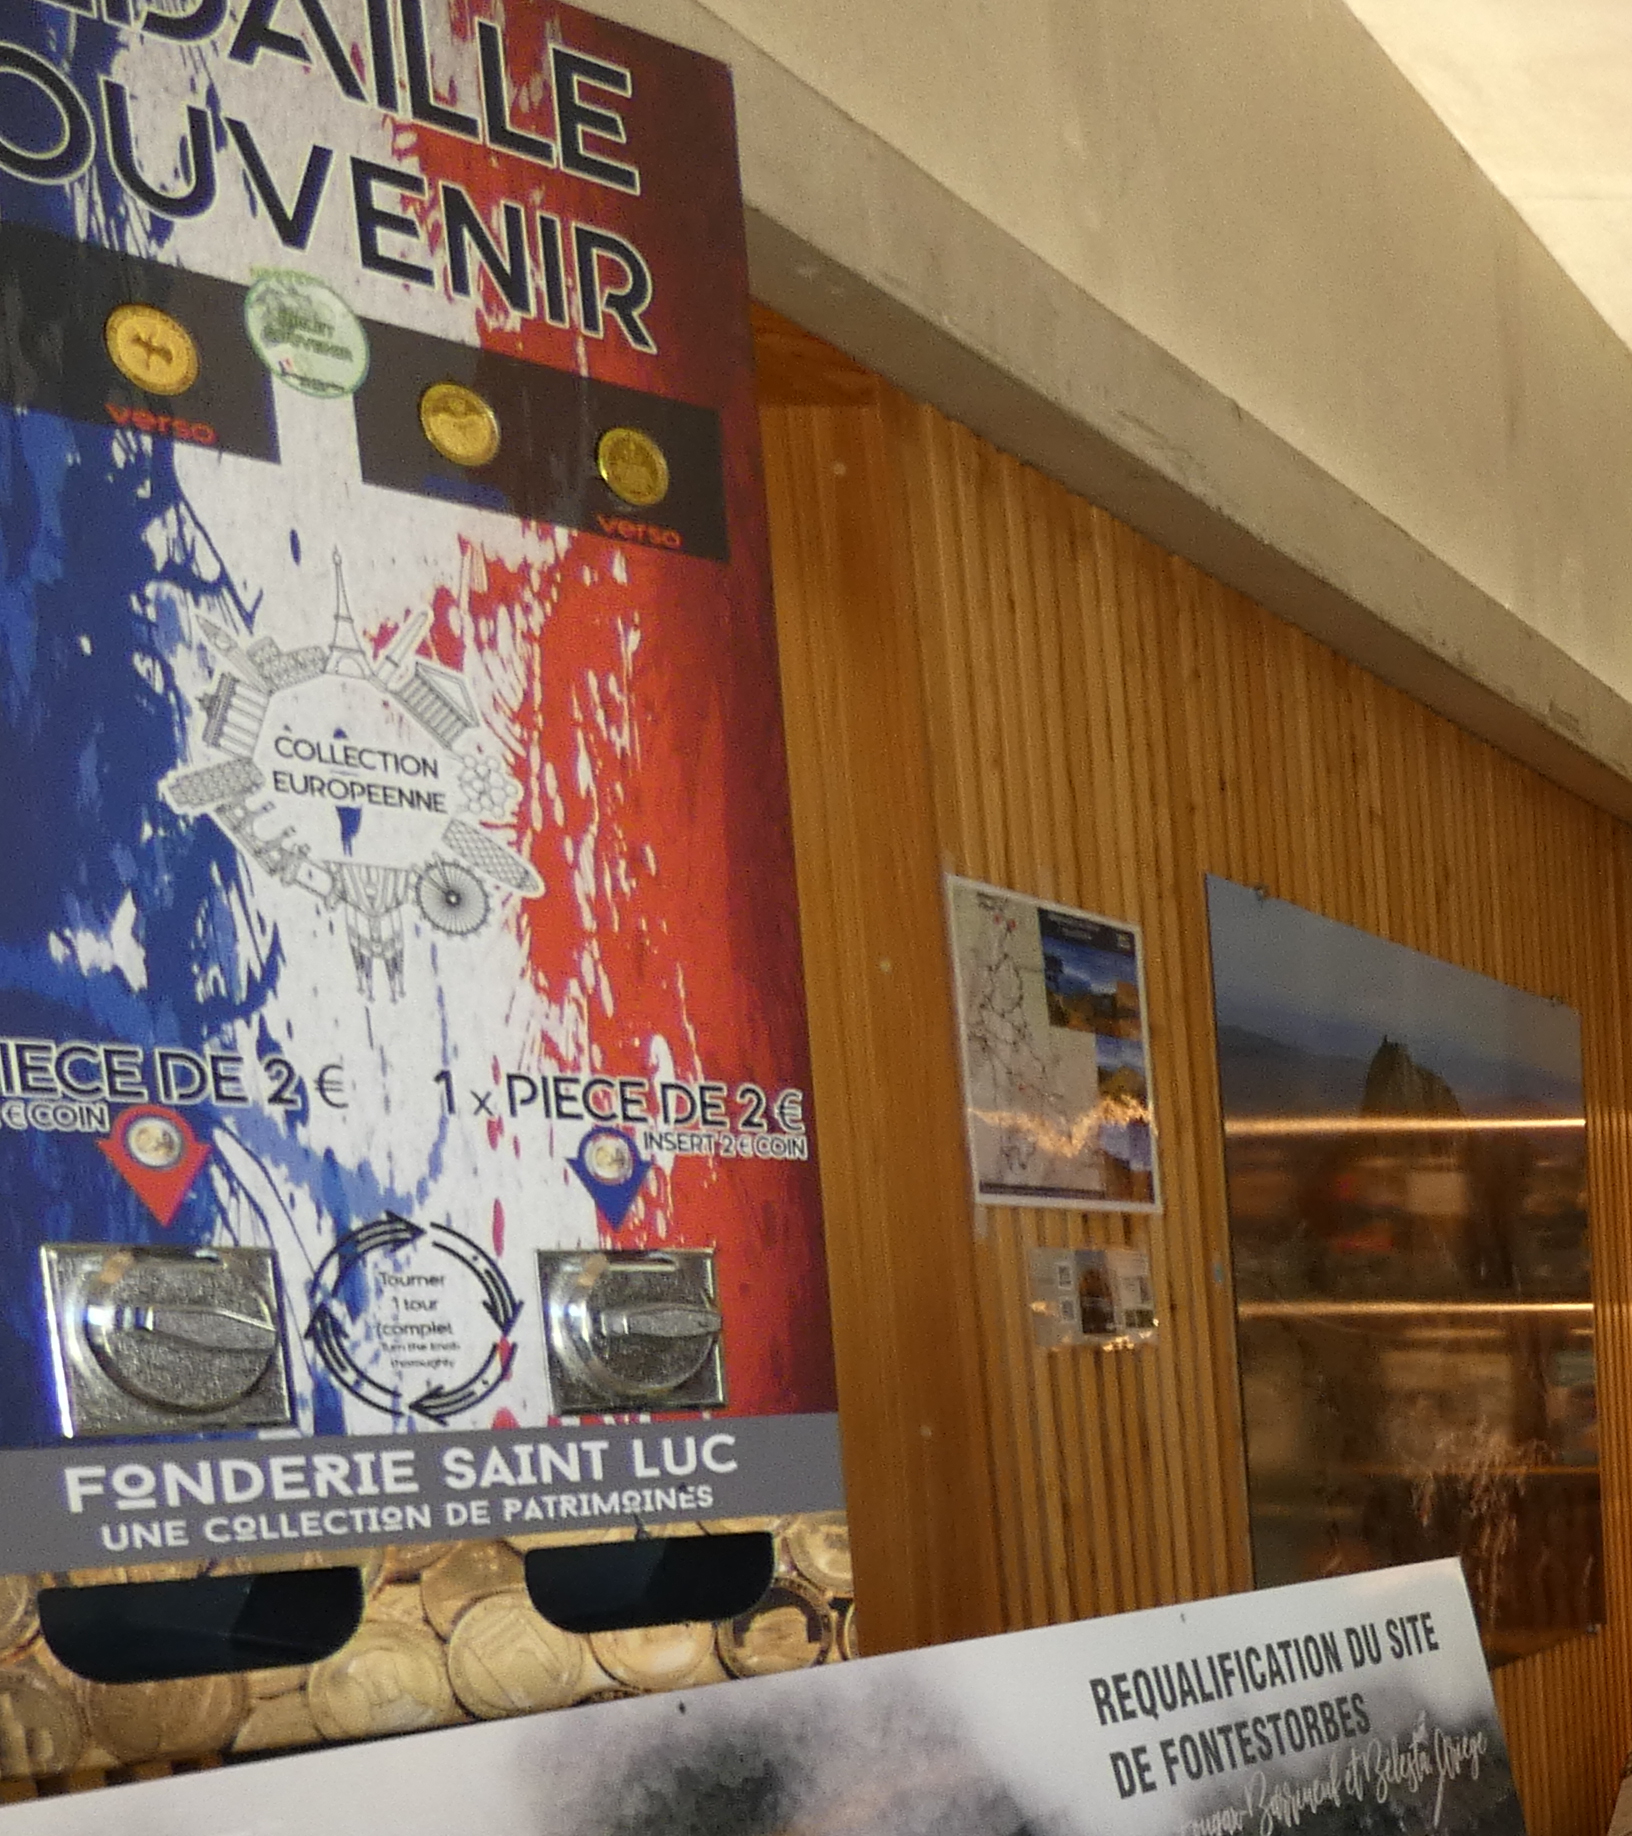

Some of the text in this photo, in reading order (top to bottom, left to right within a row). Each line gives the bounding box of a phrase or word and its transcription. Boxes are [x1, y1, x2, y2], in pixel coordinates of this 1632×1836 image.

[57, 0, 638, 196] AILLE
[107, 403, 217, 445] verso
[598, 516, 682, 550] verso
[274, 733, 439, 779] COLLECTION
[272, 768, 448, 815] EUROPEENNE
[155, 1047, 251, 1106] DE
[263, 1056, 301, 1108] 2
[314, 1063, 349, 1109] €
[433, 1069, 805, 1133] 1 x PIECE DE 2 €
[29, 1103, 110, 1132] COIN
[643, 1131, 716, 1153] INSERT
[720, 1135, 735, 1157] 2
[755, 1136, 809, 1160] COIN
[65, 1433, 739, 1512] FONDERIE SAINT LUC
[102, 1486, 714, 1552] UNE COLLECTION DE PATRIMOINES
[1089, 1611, 1440, 1727] REQUALIFICATION DU SITE
[1110, 1693, 1371, 1800] DE FONTESTORBES
